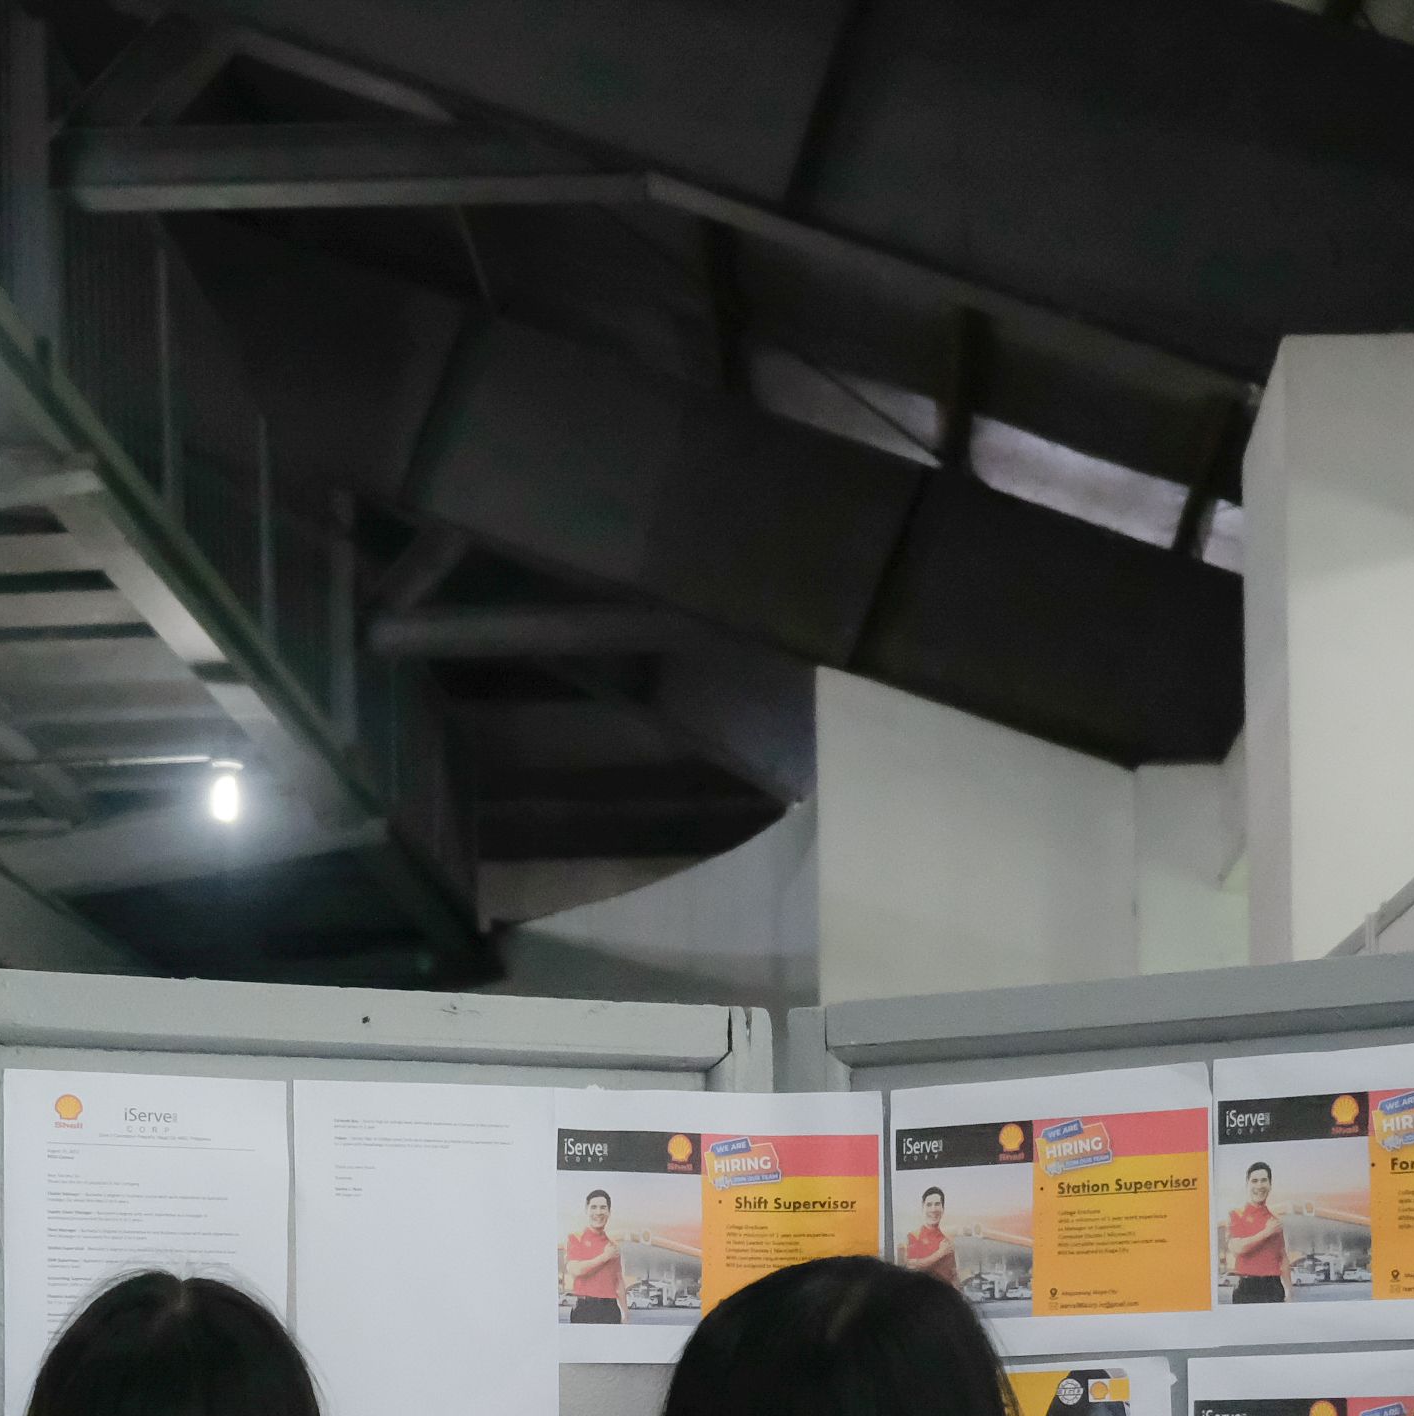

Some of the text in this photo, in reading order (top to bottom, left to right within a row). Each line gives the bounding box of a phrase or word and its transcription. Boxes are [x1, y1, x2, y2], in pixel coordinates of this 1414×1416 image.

[124, 1108, 172, 1122] iServe
[1226, 1110, 1265, 1128] iServe
[564, 1138, 603, 1156] iServe
[1046, 1137, 1103, 1158] HIRING
[714, 1156, 772, 1173] HIRING
[1057, 1176, 1197, 1195] Station Supervisor
[735, 1197, 856, 1212] Shift Supervisor
